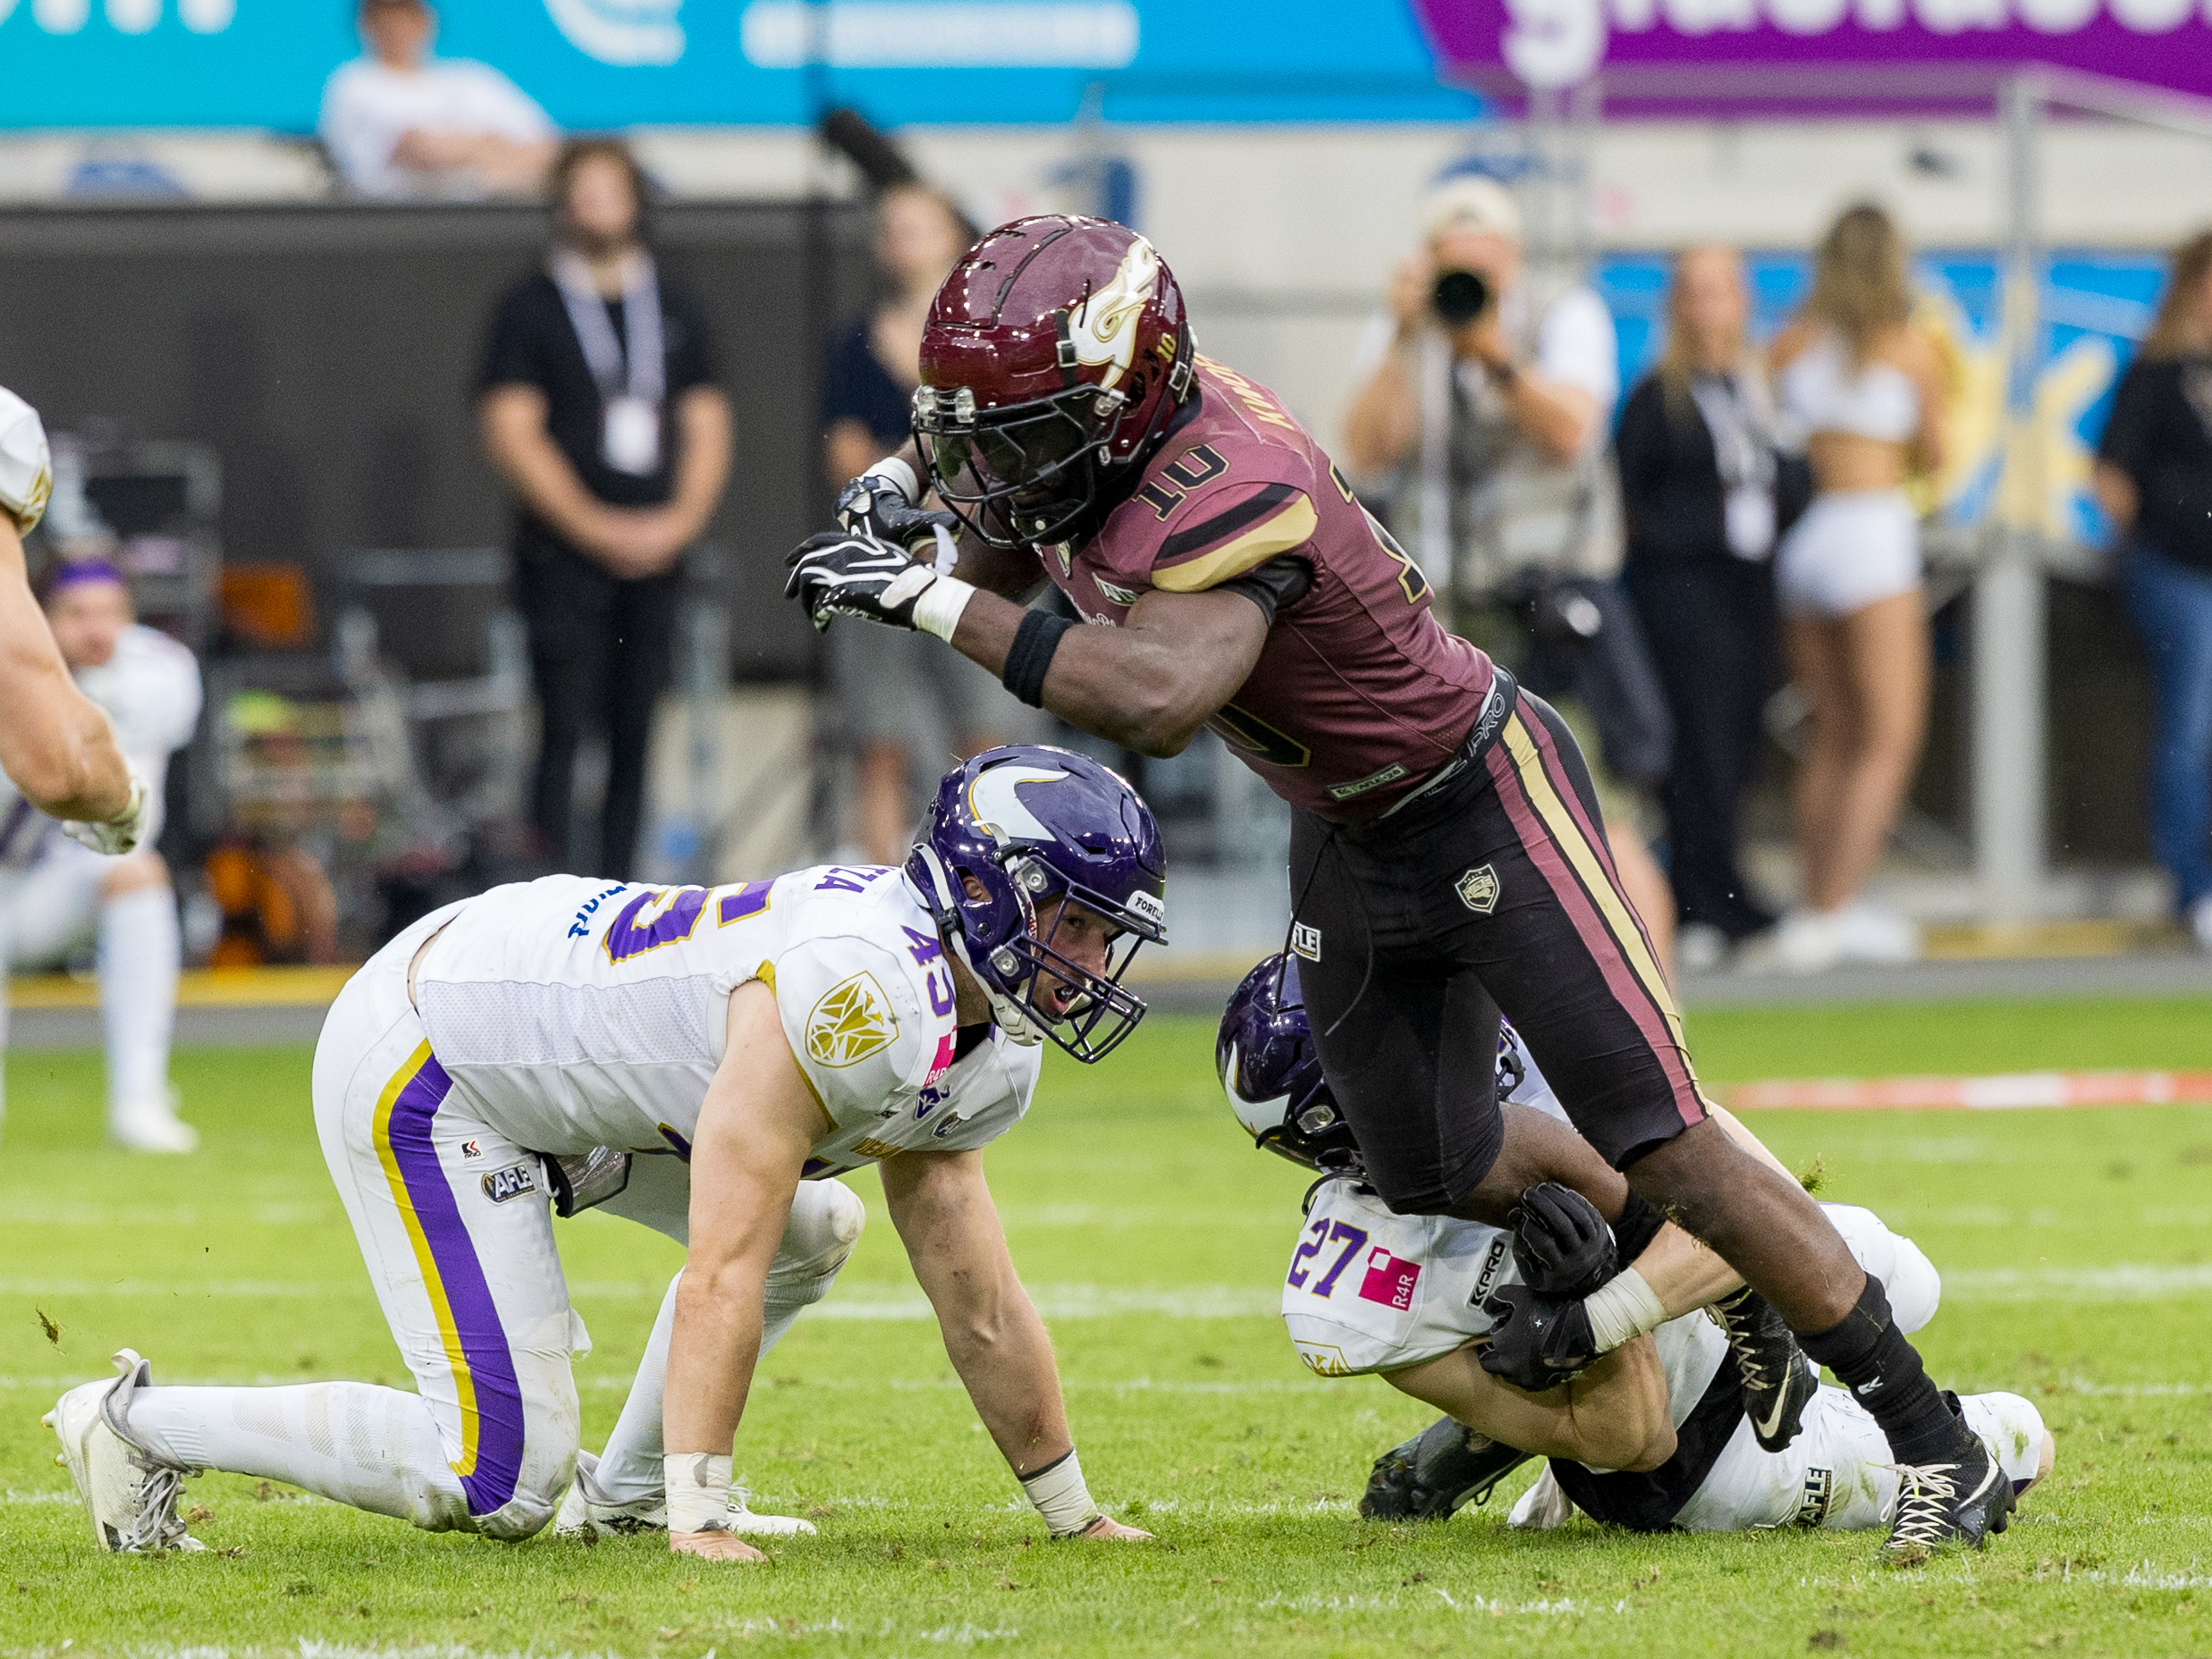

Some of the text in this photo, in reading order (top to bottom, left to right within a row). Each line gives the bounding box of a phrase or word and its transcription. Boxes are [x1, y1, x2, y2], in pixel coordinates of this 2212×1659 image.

[1157, 333, 1176, 363] 10
[1131, 443, 1230, 522] 10
[1293, 925, 1317, 953] FLE
[899, 924, 958, 1019] 45
[494, 1165, 534, 1199] AFLE
[1288, 1217, 1369, 1300] 27
[1391, 1273, 1415, 1308] R4R
